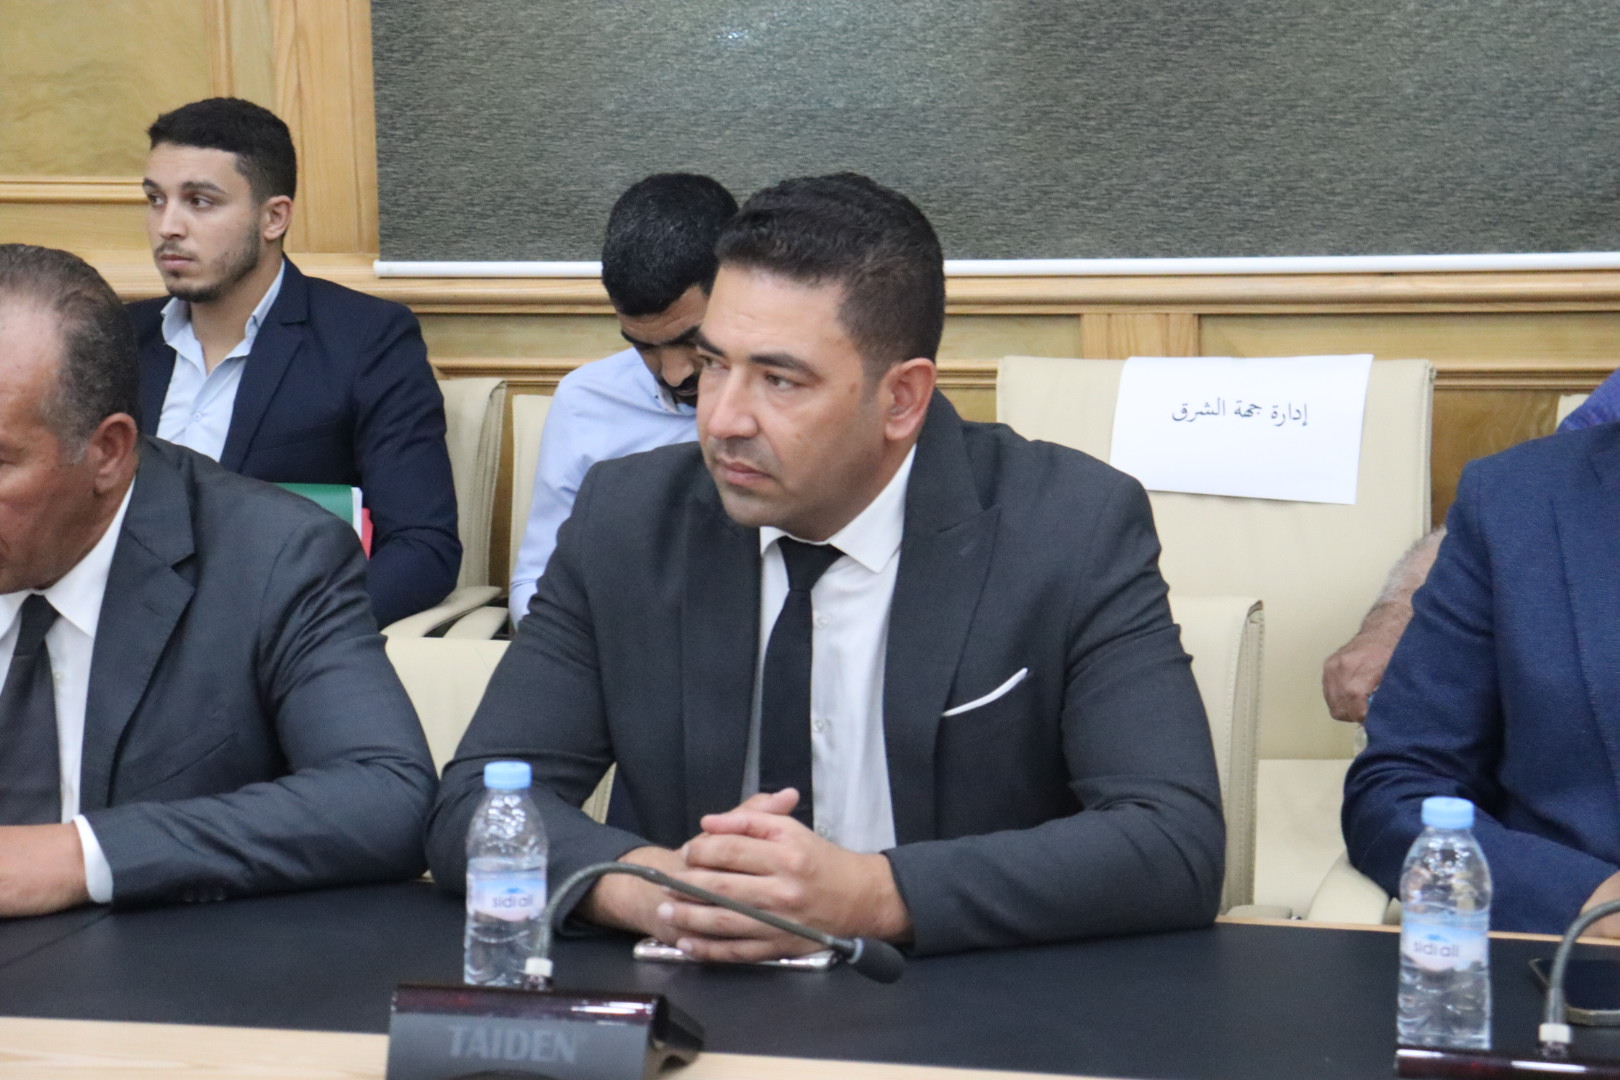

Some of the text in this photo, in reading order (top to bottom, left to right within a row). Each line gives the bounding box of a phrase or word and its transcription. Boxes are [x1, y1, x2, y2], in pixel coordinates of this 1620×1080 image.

[1171, 397, 1308, 427] إدارة جهة الشرق
[492, 895, 534, 908] sidi ali
[1413, 941, 1460, 957] sidi ali
[450, 1023, 577, 1064] TAIDEN
